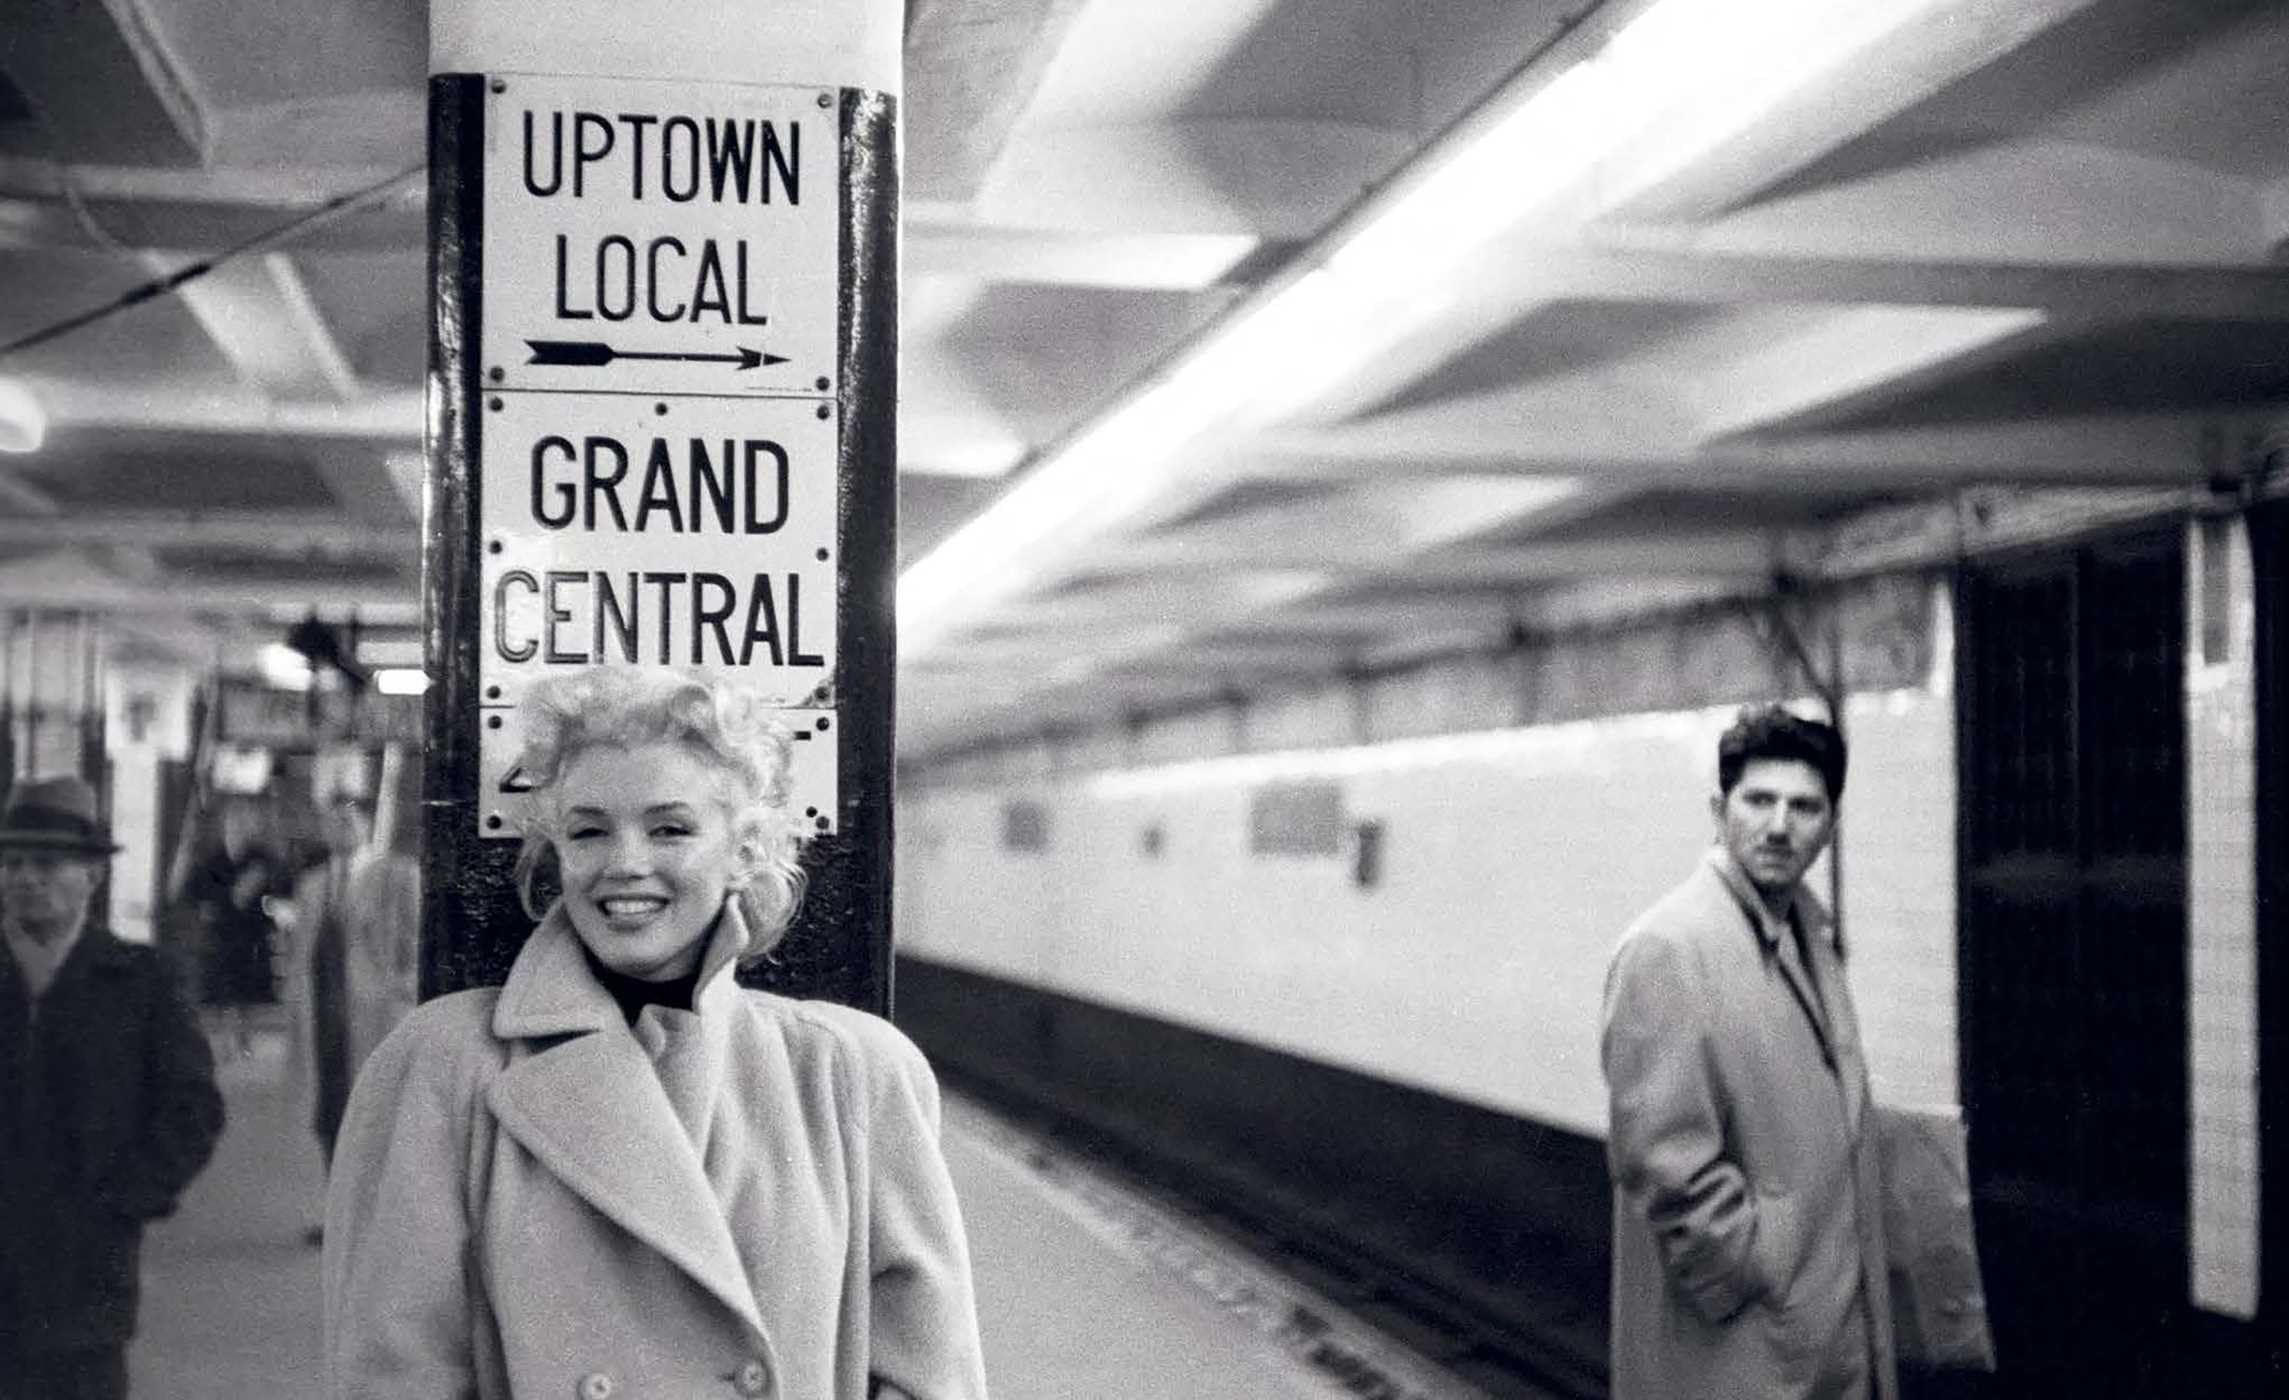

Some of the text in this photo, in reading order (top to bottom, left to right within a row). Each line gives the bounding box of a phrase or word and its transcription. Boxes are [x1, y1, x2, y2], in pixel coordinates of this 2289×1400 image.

[523, 110, 799, 205] UPTOWN
[556, 234, 767, 326] LOCAL
[531, 435, 789, 535] GRAND
[494, 569, 825, 668] CENTRAL
